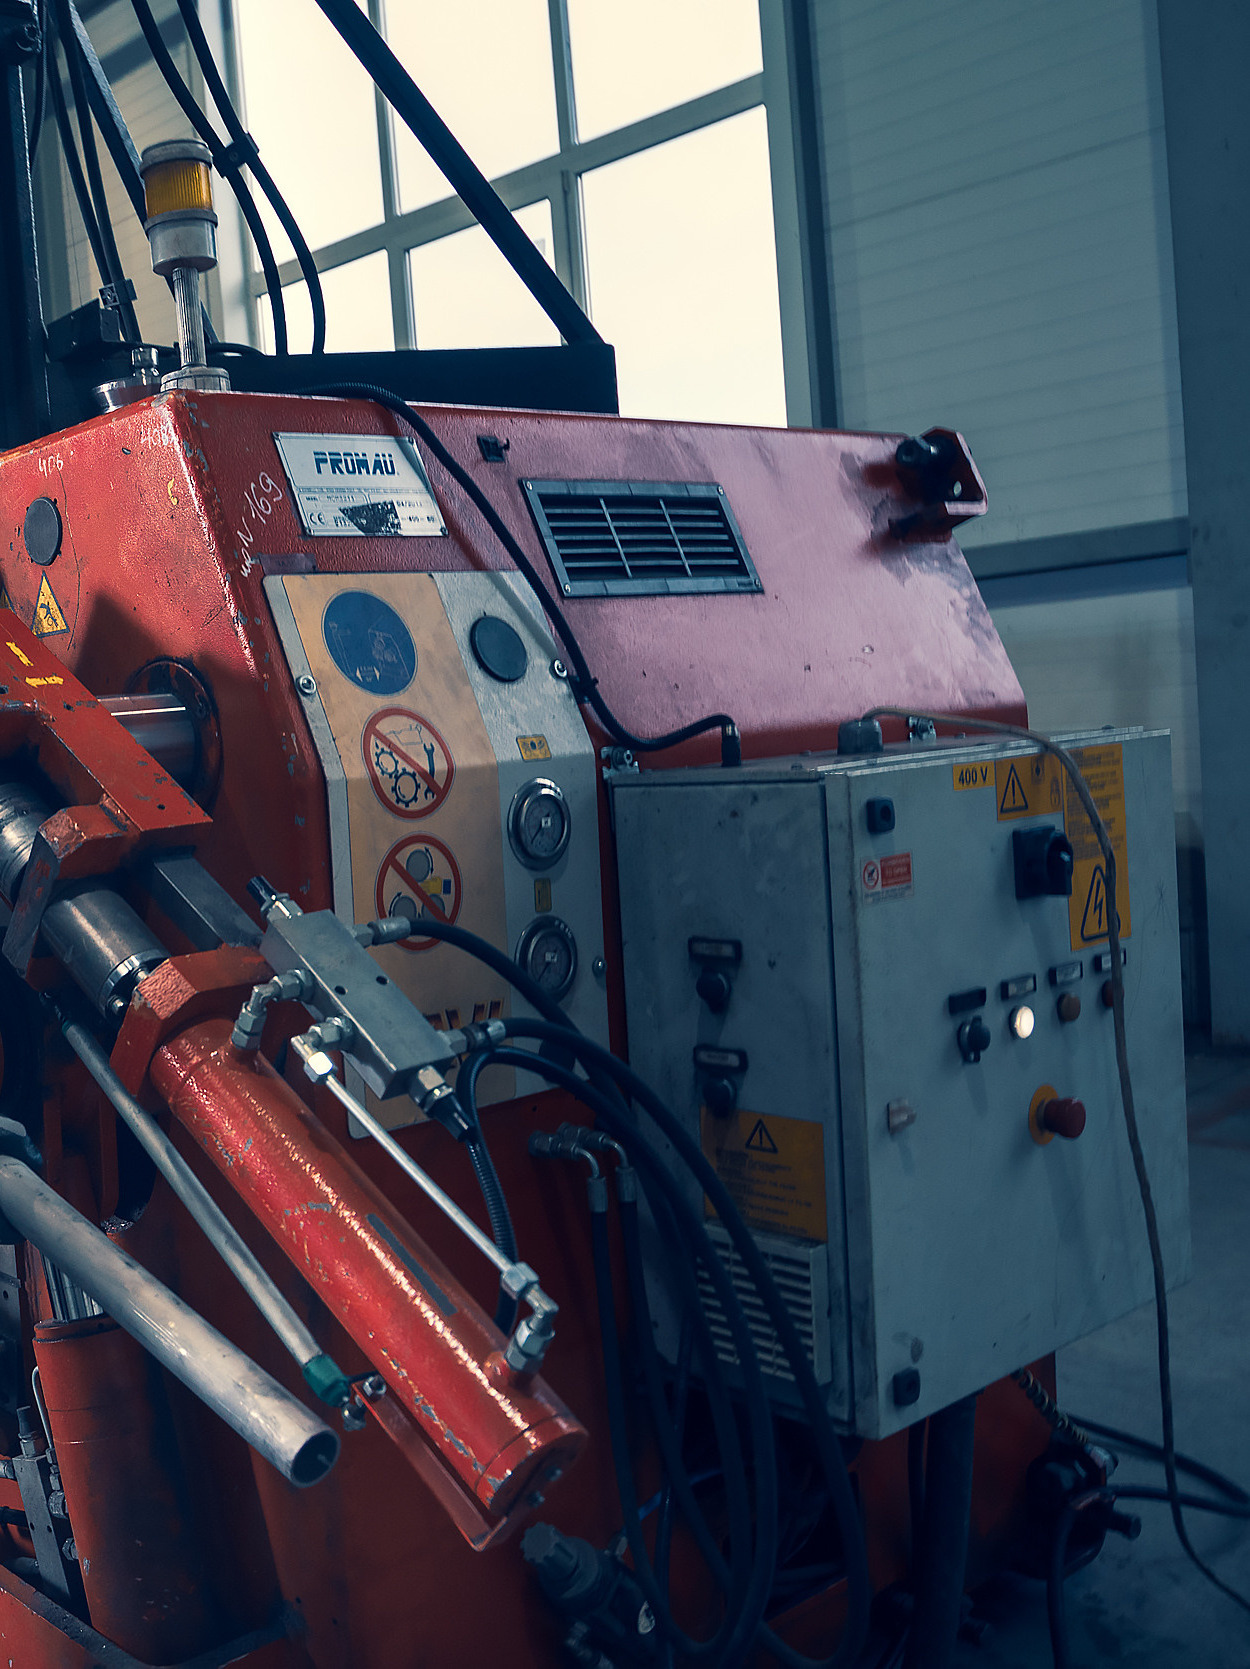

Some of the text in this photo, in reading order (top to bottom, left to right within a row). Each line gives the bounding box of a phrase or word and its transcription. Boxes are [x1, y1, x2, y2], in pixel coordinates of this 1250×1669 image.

[313, 450, 396, 476] PROMAU
[244, 471, 283, 525] 169
[958, 766, 988, 787] 400 V
